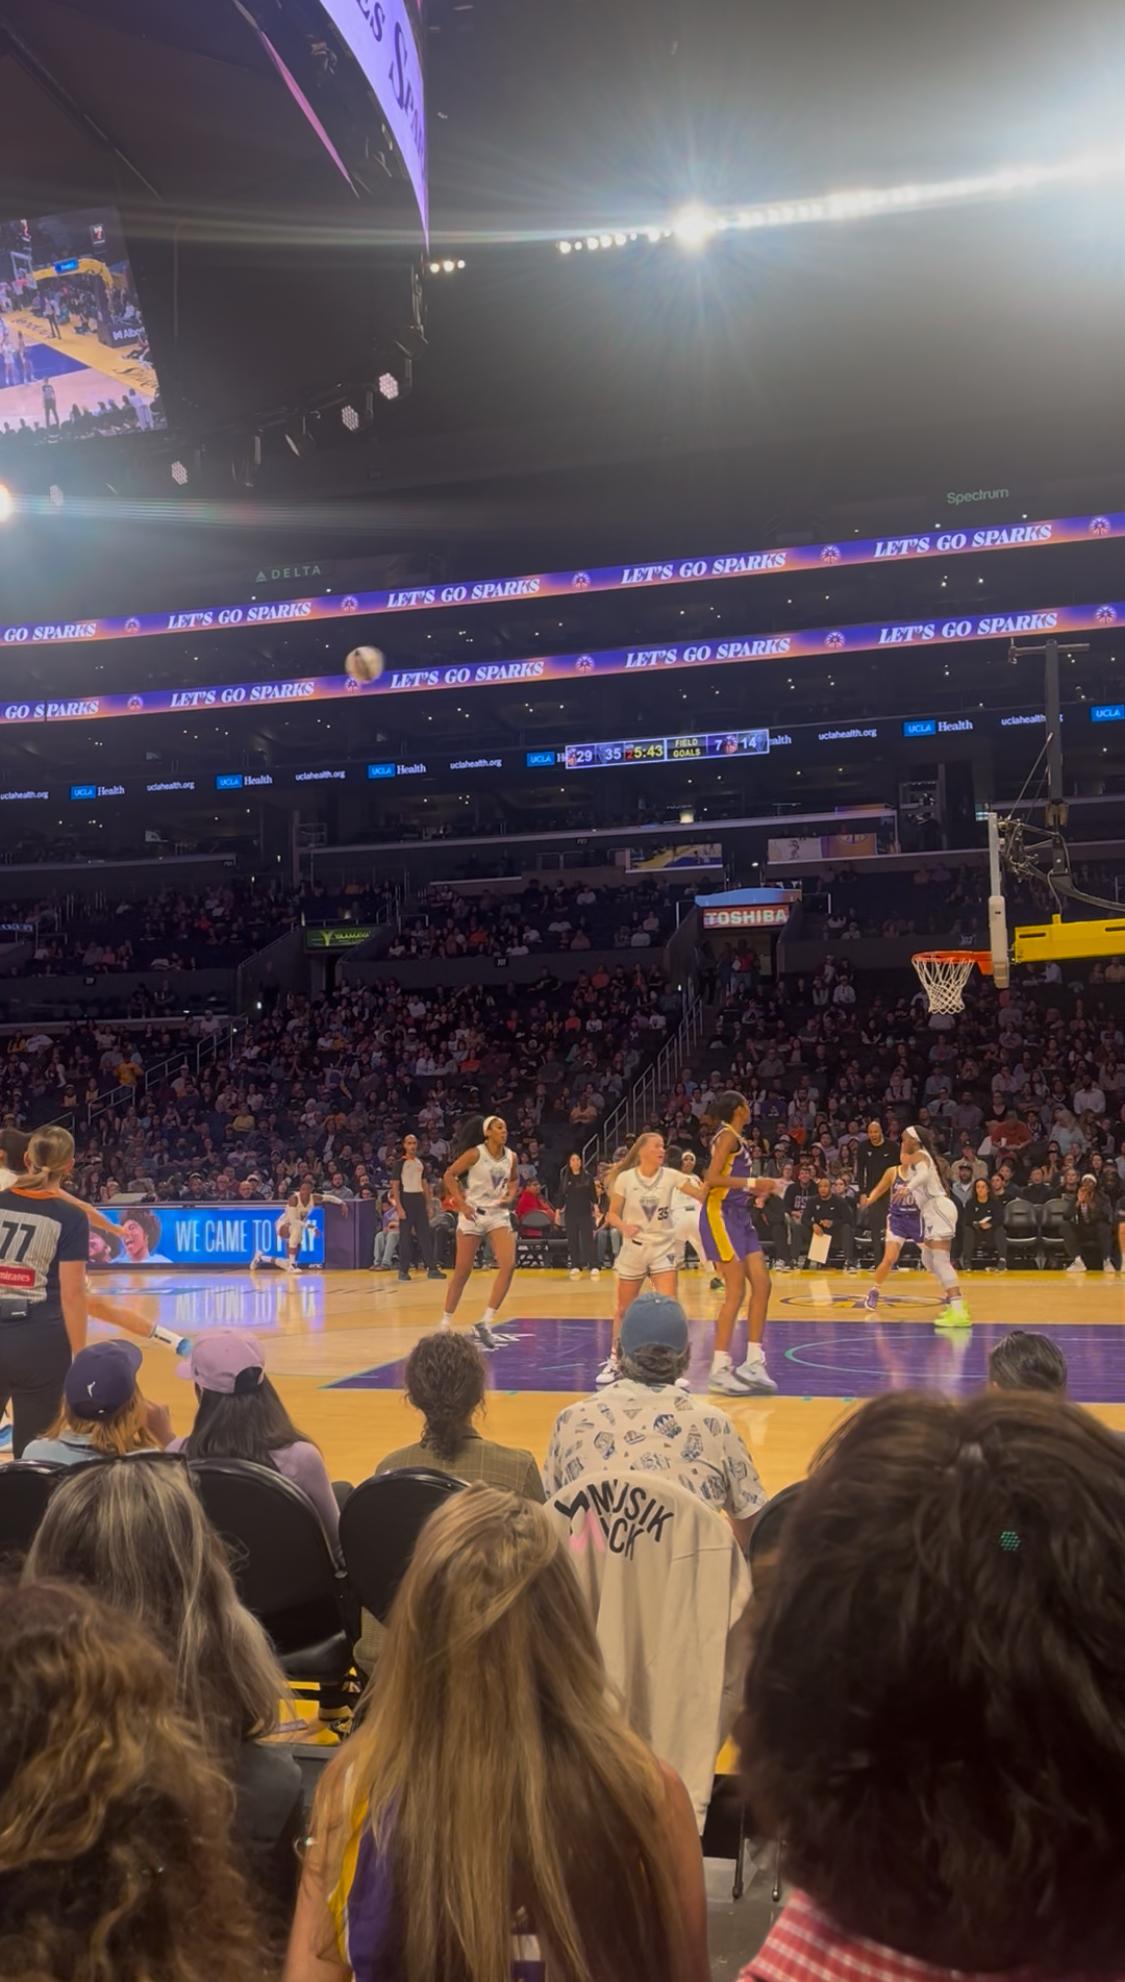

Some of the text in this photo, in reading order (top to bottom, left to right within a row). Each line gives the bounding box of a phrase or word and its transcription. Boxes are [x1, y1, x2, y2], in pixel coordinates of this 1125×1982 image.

[946, 488, 1009, 506] Spectrum
[873, 524, 1052, 558] LET'S GO SPARKS
[271, 565, 321, 580] DELTA
[621, 552, 786, 585] LET'S GO SPARKS
[387, 578, 540, 608] LET'S GO SPARKS
[167, 602, 311, 629] LET'S GO SPARKS
[4, 624, 96, 642] GO SPARKS
[878, 612, 1057, 645] LET'S GO SPARKS
[625, 637, 791, 669] LET'S GO SPARKS
[390, 661, 544, 689] LET'S GO SPARKS
[170, 682, 314, 707] LET'S GO SPARKS
[5, 701, 99, 719] GO SPARKS
[1095, 709, 1121, 718] UCLA
[818, 727, 877, 741] uclahealth.org
[908, 719, 973, 733] UCLA Health
[675, 738, 698, 748] FIELD
[715, 734, 756, 751] 7 14
[530, 754, 551, 764] UCLA
[576, 750, 592, 763] 29
[606, 748, 621, 760] 35
[634, 744, 663, 758] 5:43
[673, 748, 701, 758] GOALS
[371, 763, 426, 776] UCLA Health
[450, 758, 502, 770] uclahealth.org
[219, 774, 273, 786] UCLA Health
[295, 769, 345, 781] uclahealth.org
[74, 785, 125, 797] UCLA Health
[147, 780, 195, 791] uclahealth.org
[705, 909, 788, 925] TOSHIBA
[0, 1220, 37, 1263] 77
[176, 1220, 200, 1252] WE
[205, 1219, 247, 1252] CAME
[252, 1219, 271, 1252] TO
